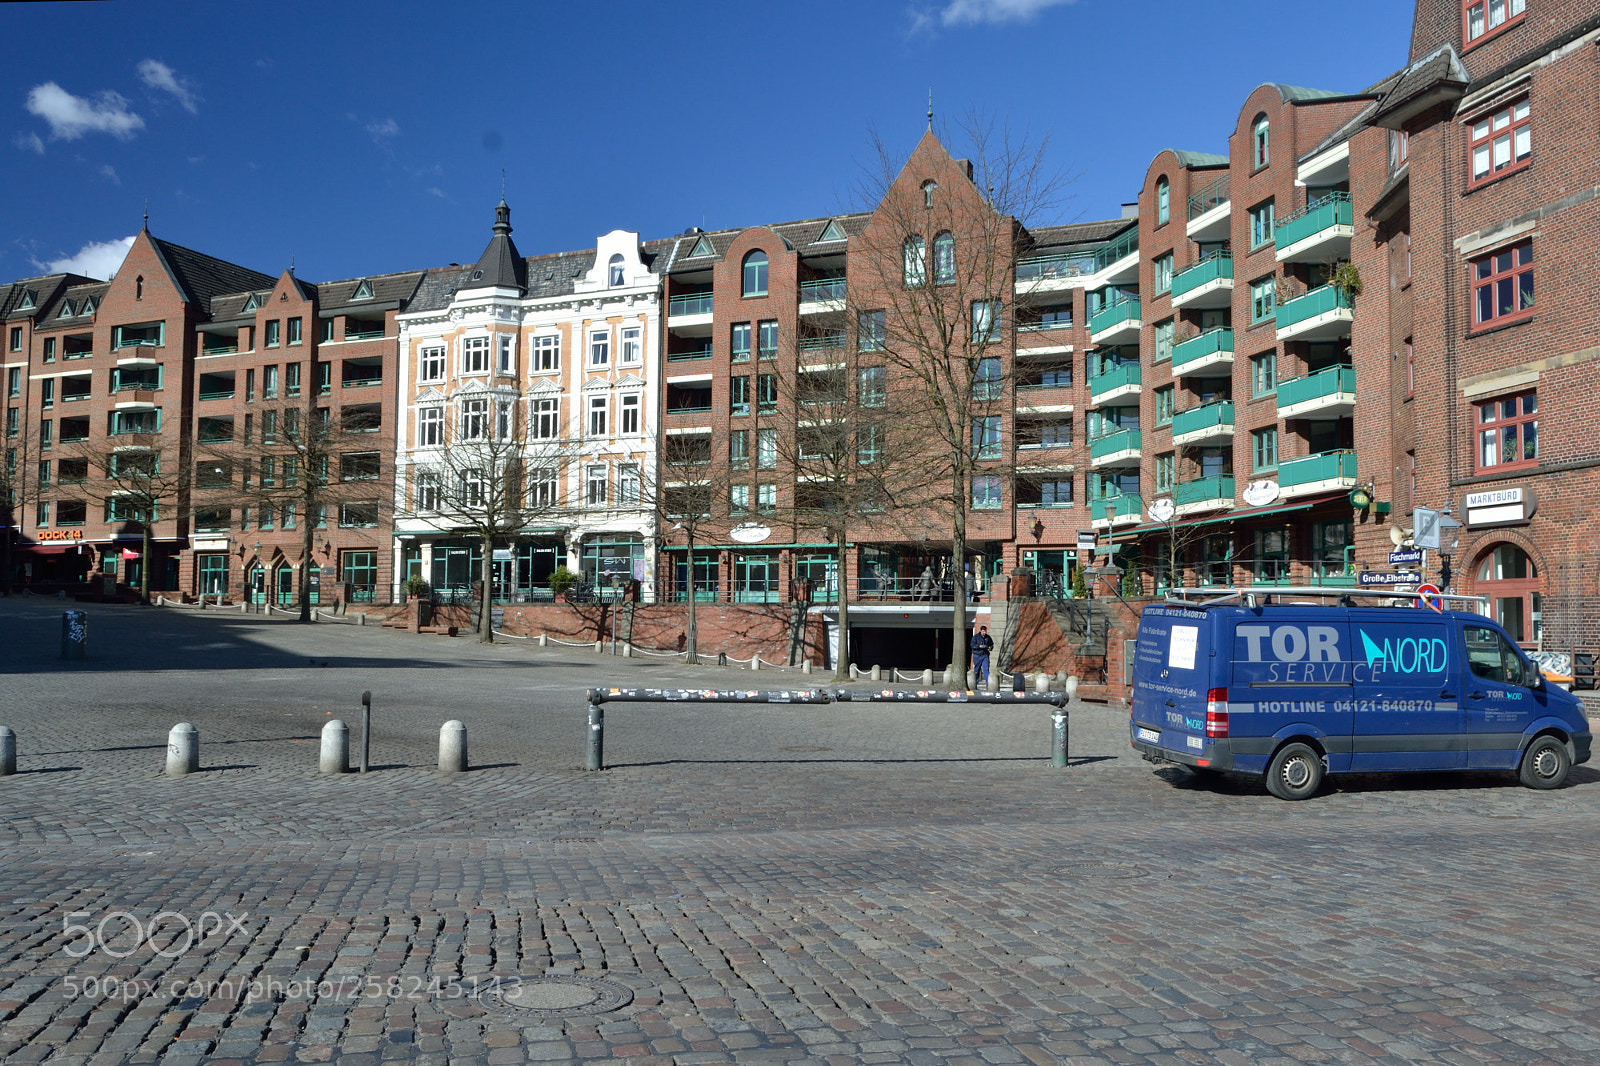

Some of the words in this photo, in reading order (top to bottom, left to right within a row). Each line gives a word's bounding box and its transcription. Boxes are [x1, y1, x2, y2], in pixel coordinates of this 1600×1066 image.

[1470, 489, 1518, 505] MARKTBÜRO
[37, 530, 67, 540] DOCK
[69, 529, 82, 539] 14
[1390, 550, 1420, 562] Fischmarkt
[1362, 574, 1385, 583] Große
[1386, 573, 1420, 583] Elbstraße
[1144, 607, 1165, 616] HOTLINE
[1236, 625, 1341, 662] TOR
[1382, 637, 1448, 674] NORD
[1267, 663, 1383, 683] SERVICE
[1138, 681, 1197, 697] www.tor-service-nord.de
[1486, 690, 1505, 698] TOR
[1257, 701, 1326, 713] HOTLINE
[1333, 699, 1433, 713] 04121-840870
[1165, 711, 1183, 724] TOR
